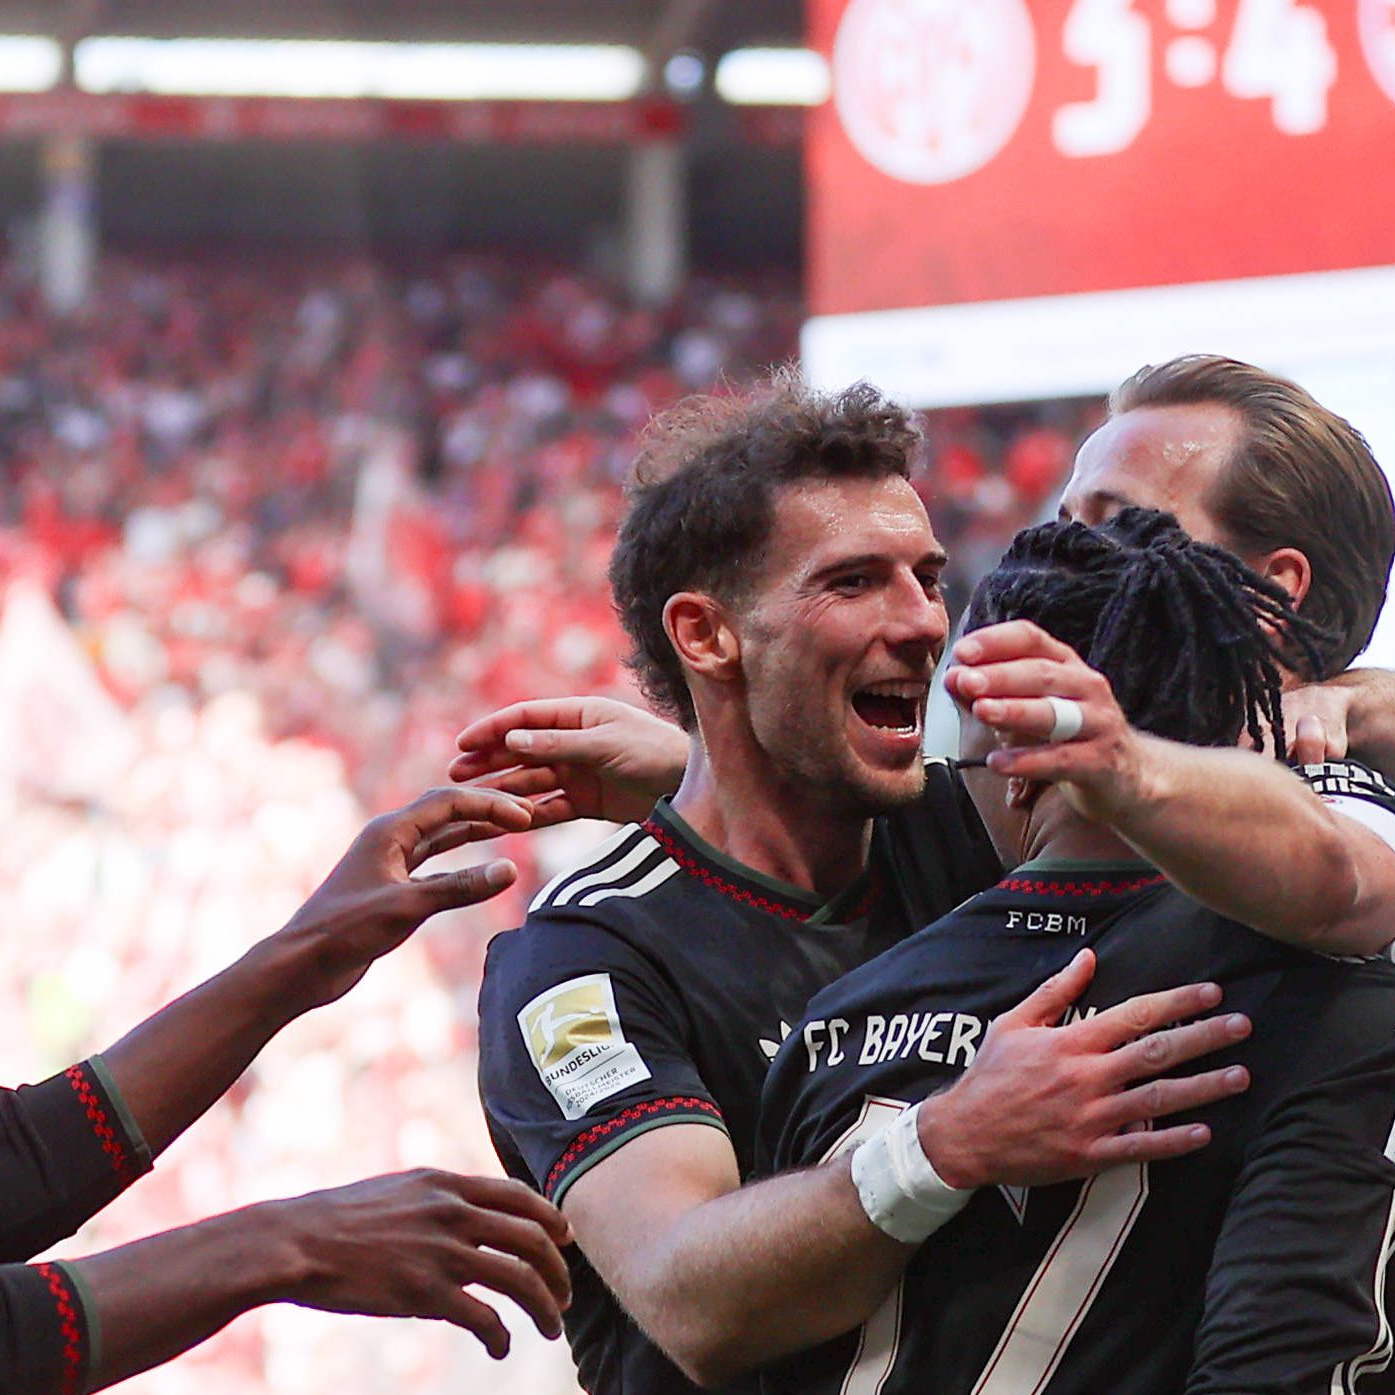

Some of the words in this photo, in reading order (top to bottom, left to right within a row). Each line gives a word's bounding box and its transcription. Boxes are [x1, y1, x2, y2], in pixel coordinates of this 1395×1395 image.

[1006, 911, 1086, 936] FCBM
[804, 1018, 851, 1073] FC
[858, 1012, 994, 1068] BAYER
